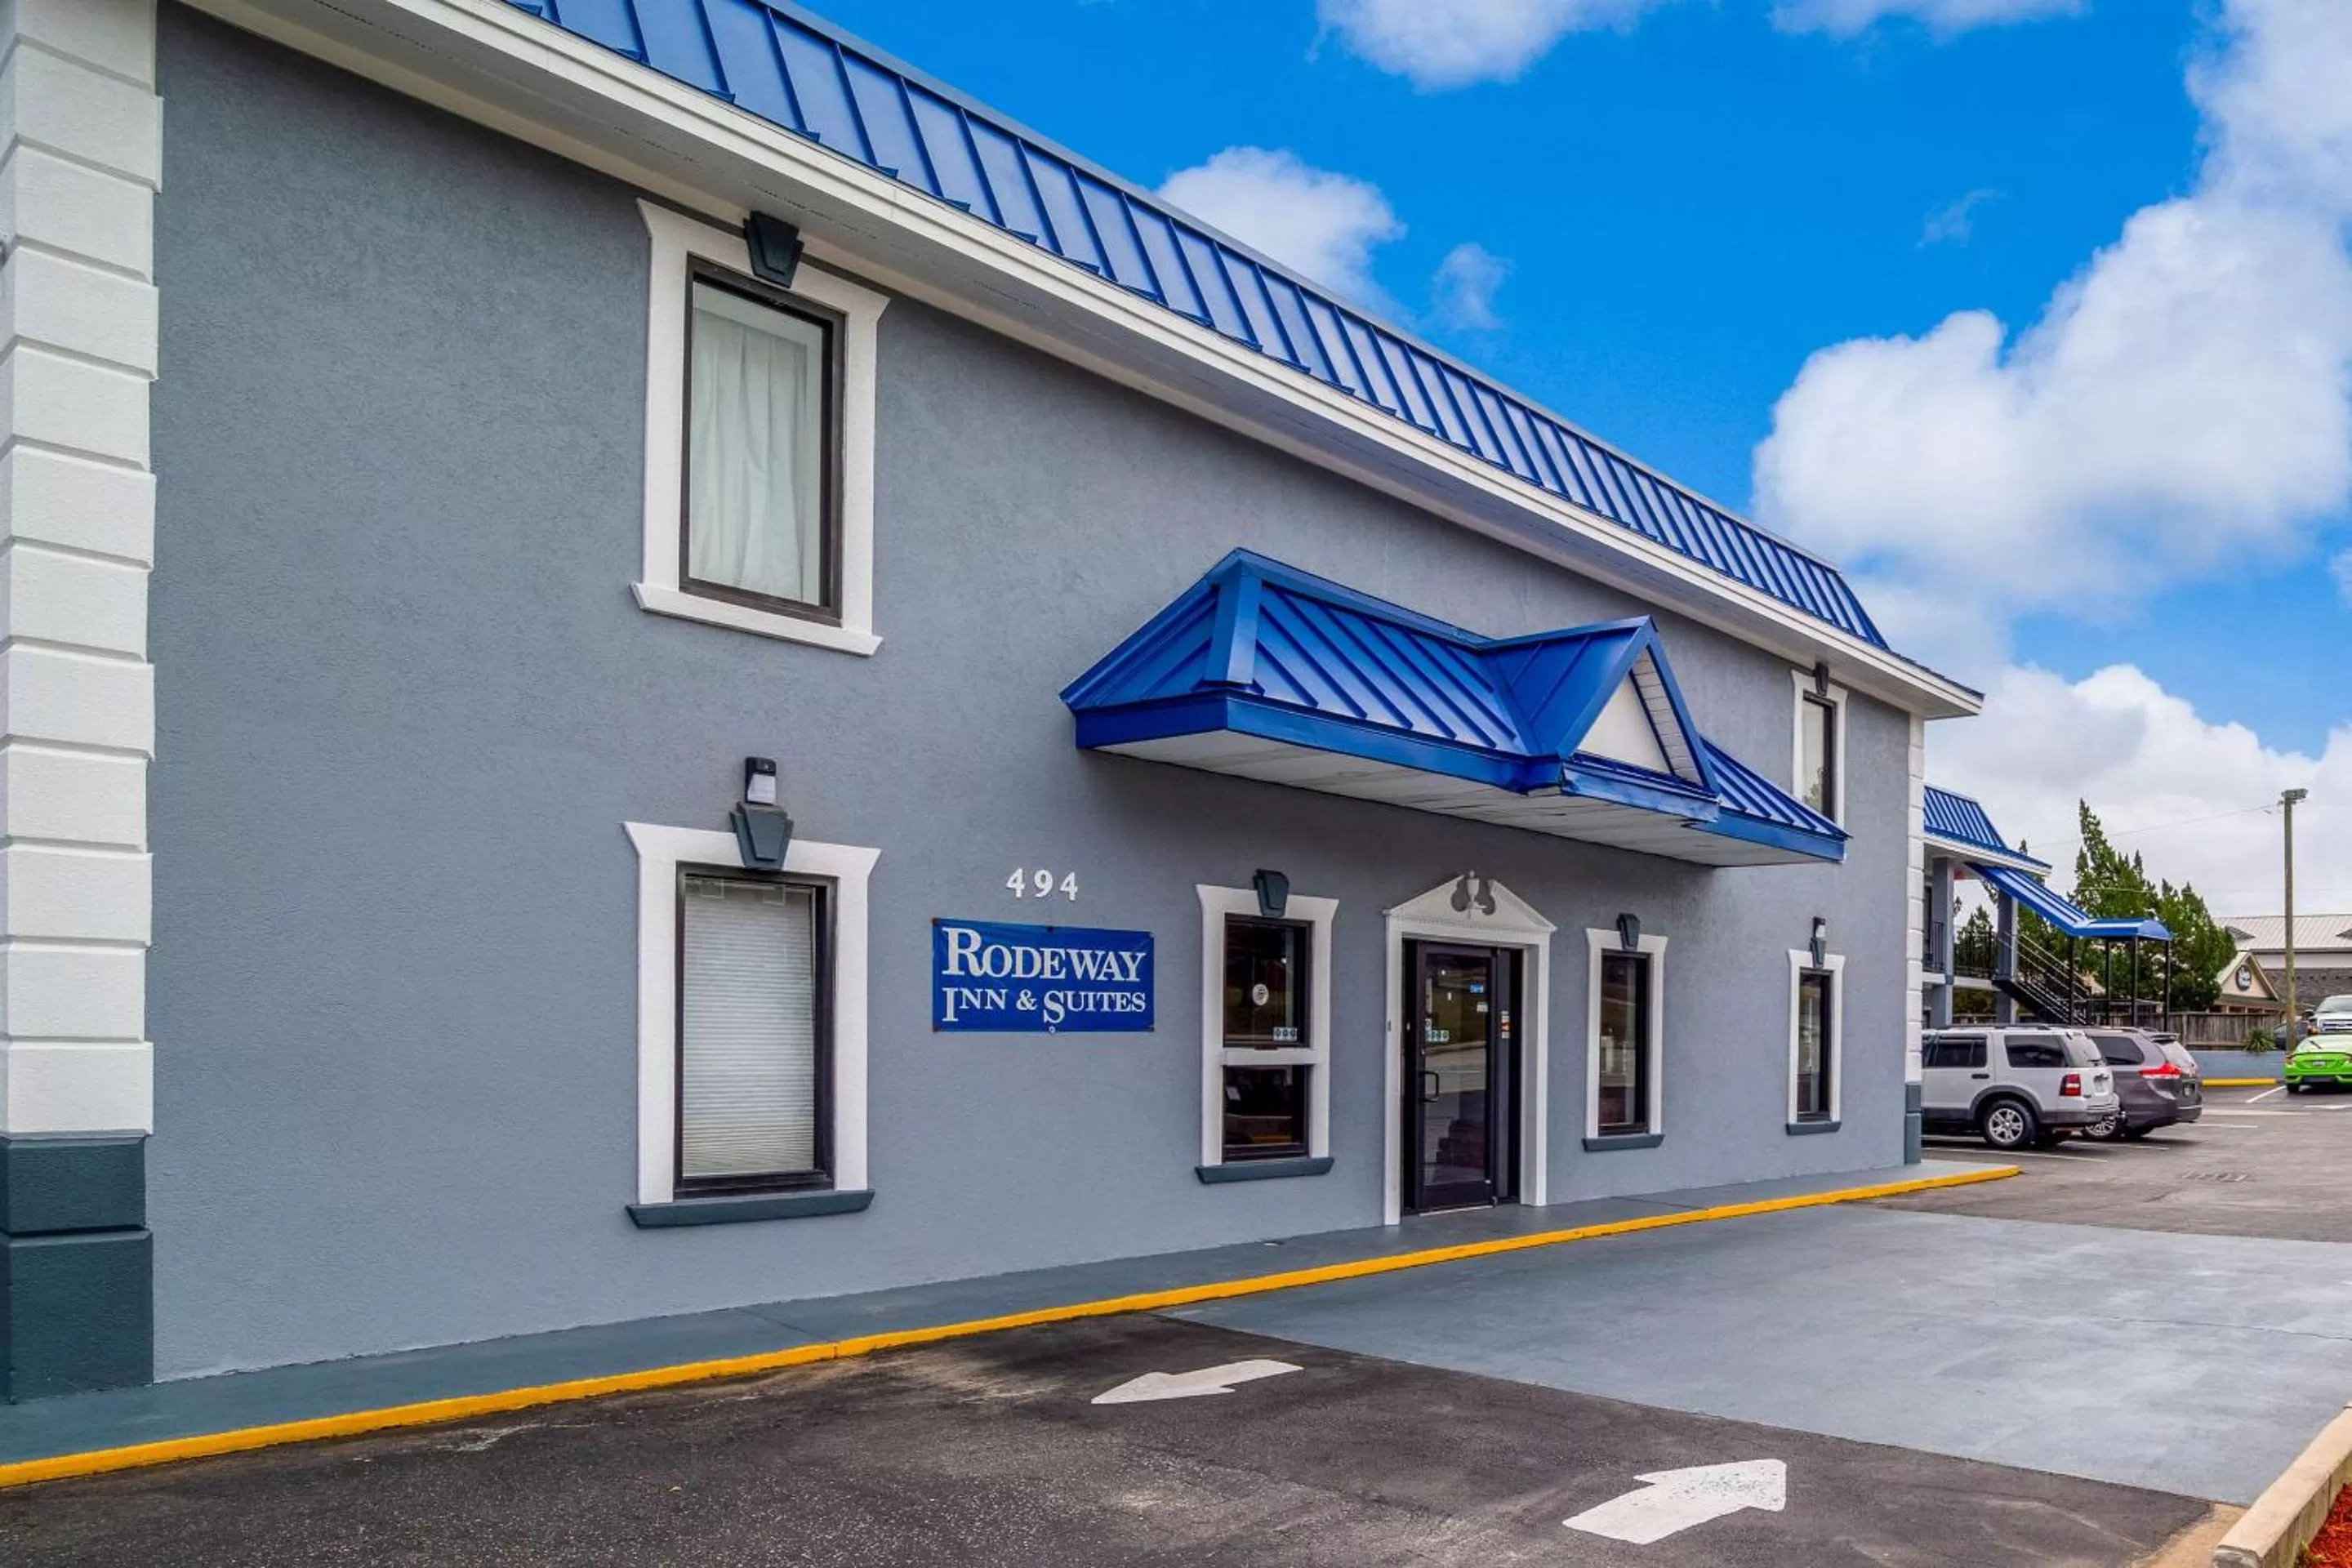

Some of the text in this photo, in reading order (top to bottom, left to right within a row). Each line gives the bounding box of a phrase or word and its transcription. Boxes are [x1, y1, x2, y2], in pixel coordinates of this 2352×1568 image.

[1006, 867, 1078, 901] 494
[942, 927, 1147, 982] RODEWAY
[942, 987, 1147, 1024] INN & SUITES
